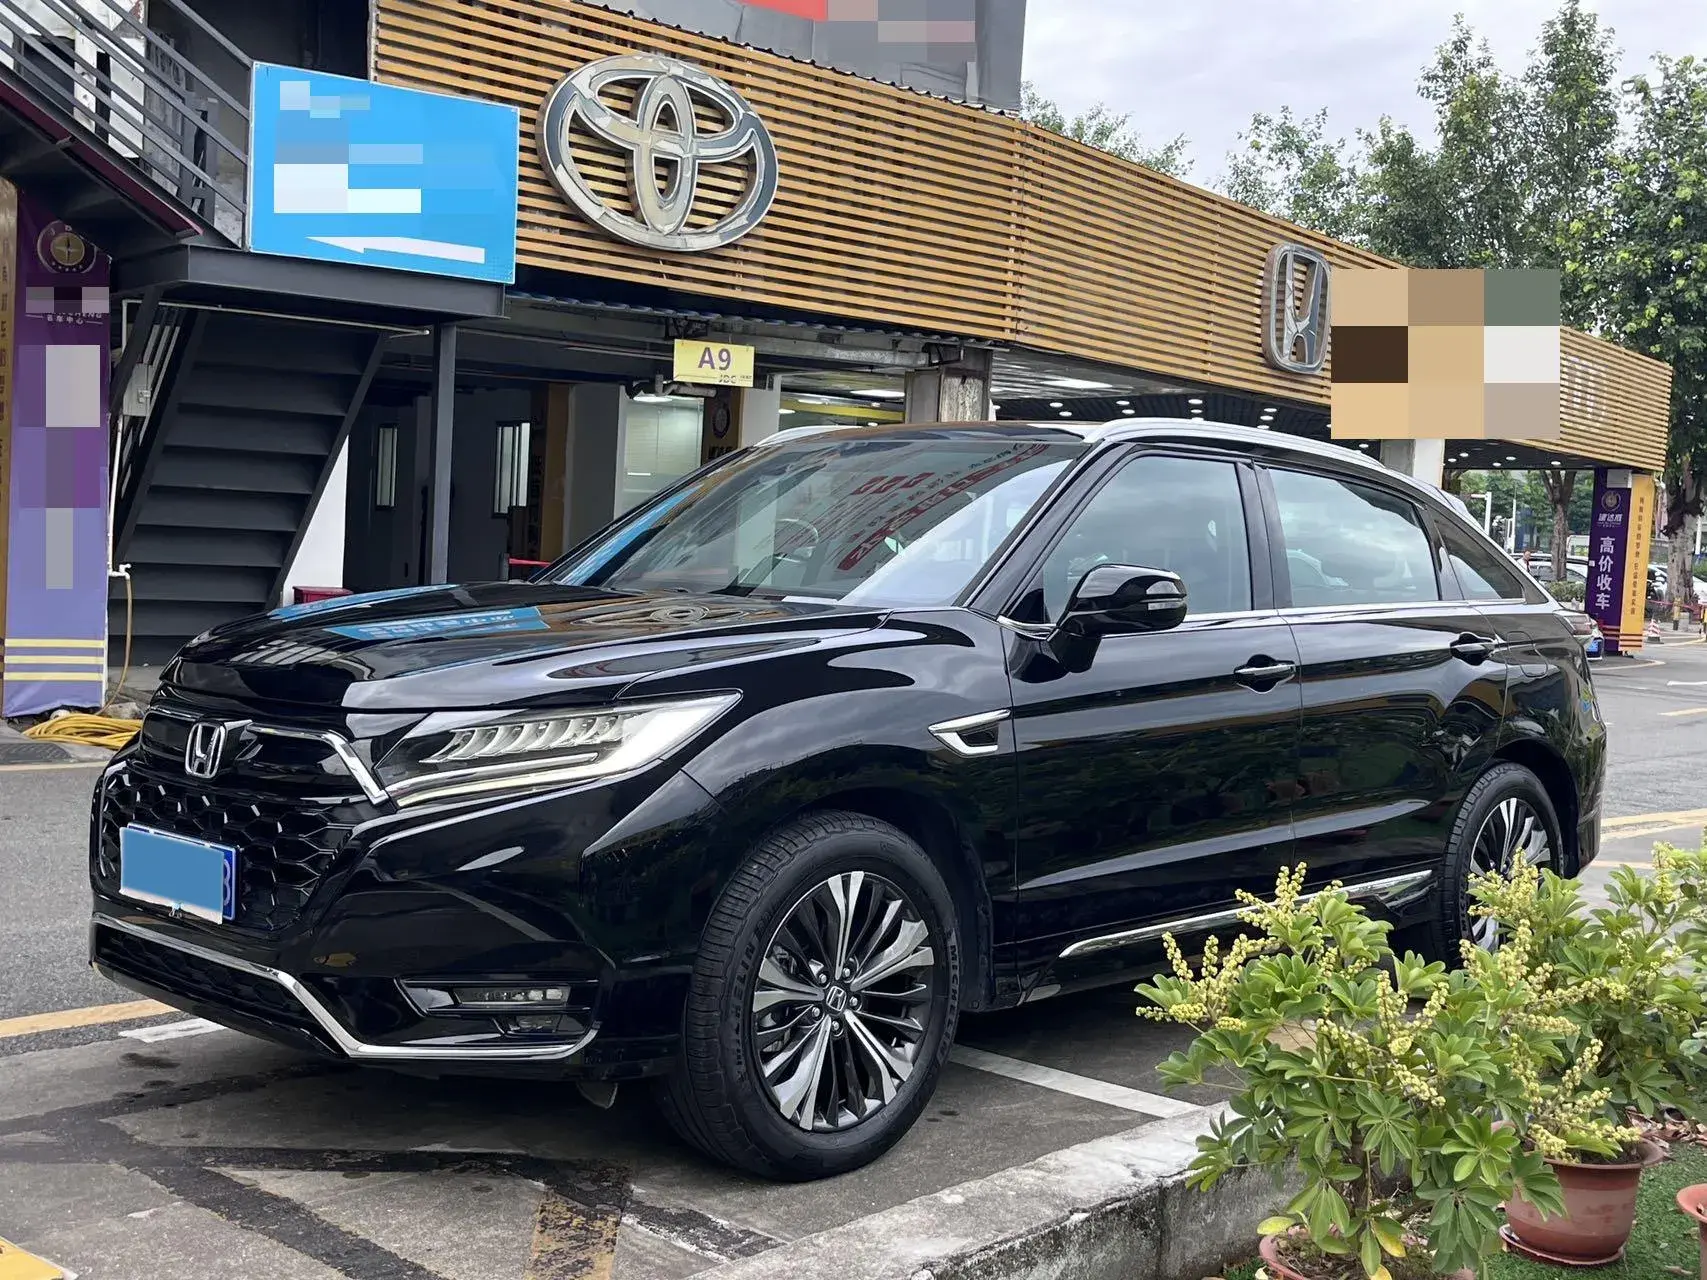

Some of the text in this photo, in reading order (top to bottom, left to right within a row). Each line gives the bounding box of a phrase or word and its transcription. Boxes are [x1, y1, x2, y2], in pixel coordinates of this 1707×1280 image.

[697, 346, 732, 371] A9
[1595, 536, 1616, 610] 高价收车
